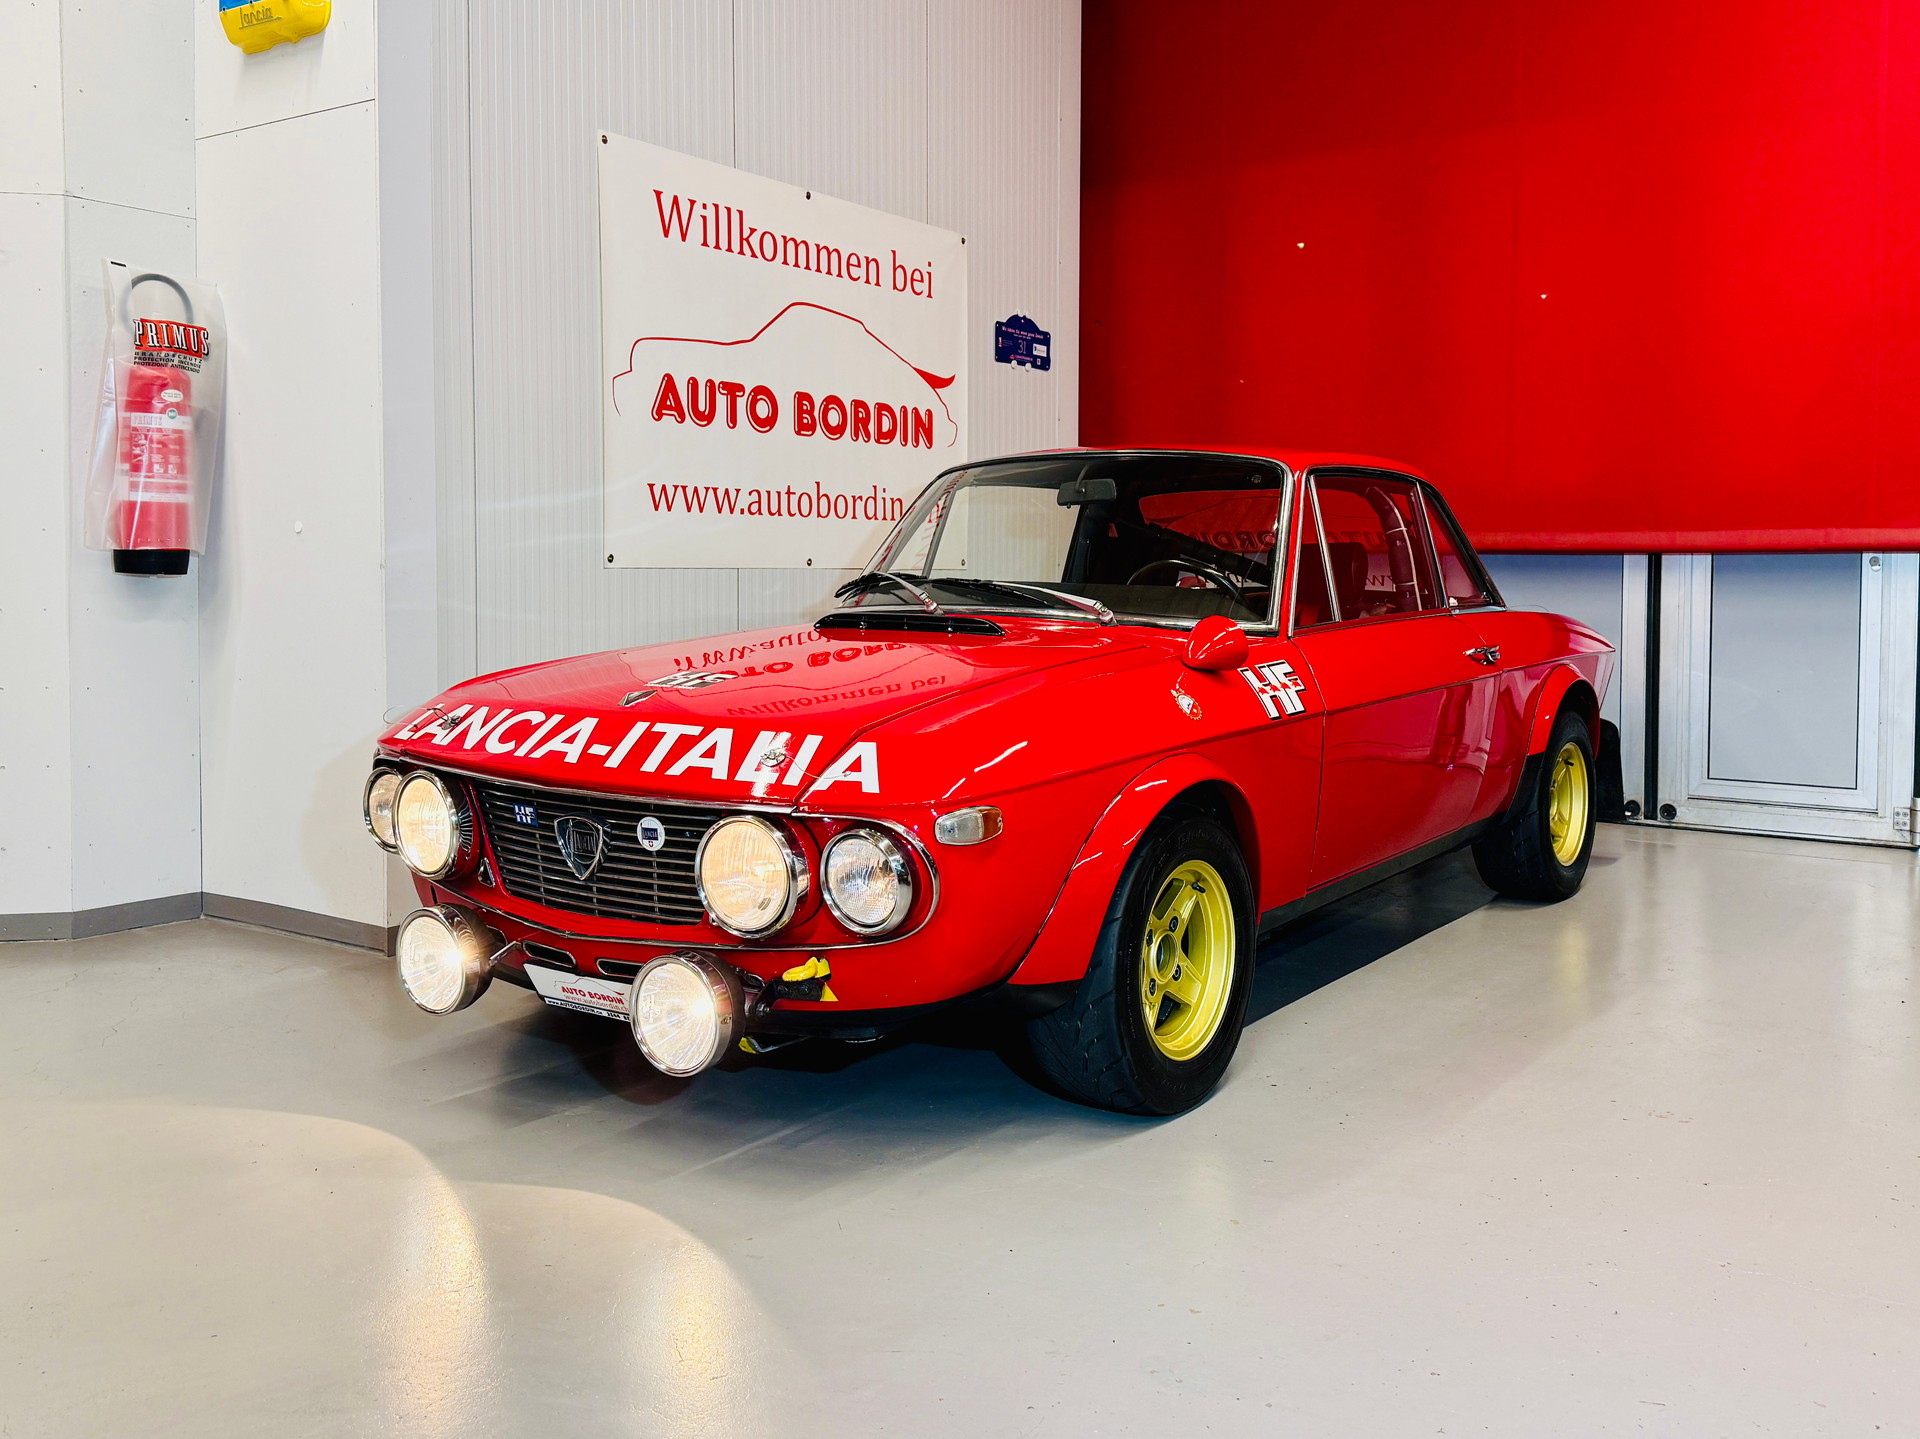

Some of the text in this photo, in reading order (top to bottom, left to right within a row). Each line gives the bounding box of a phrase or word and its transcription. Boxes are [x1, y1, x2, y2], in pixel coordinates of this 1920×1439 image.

[652, 188, 934, 299] Willkommen bei
[133, 318, 209, 357] PRIMUS
[651, 372, 934, 450] AUTO BORDIN
[646, 481, 904, 523] www.autobordin
[643, 670, 739, 690] HF
[1237, 659, 1307, 722] HF
[392, 702, 881, 794] LANCIA-ITALIA
[561, 985, 625, 1005] AUTO BORDIN
